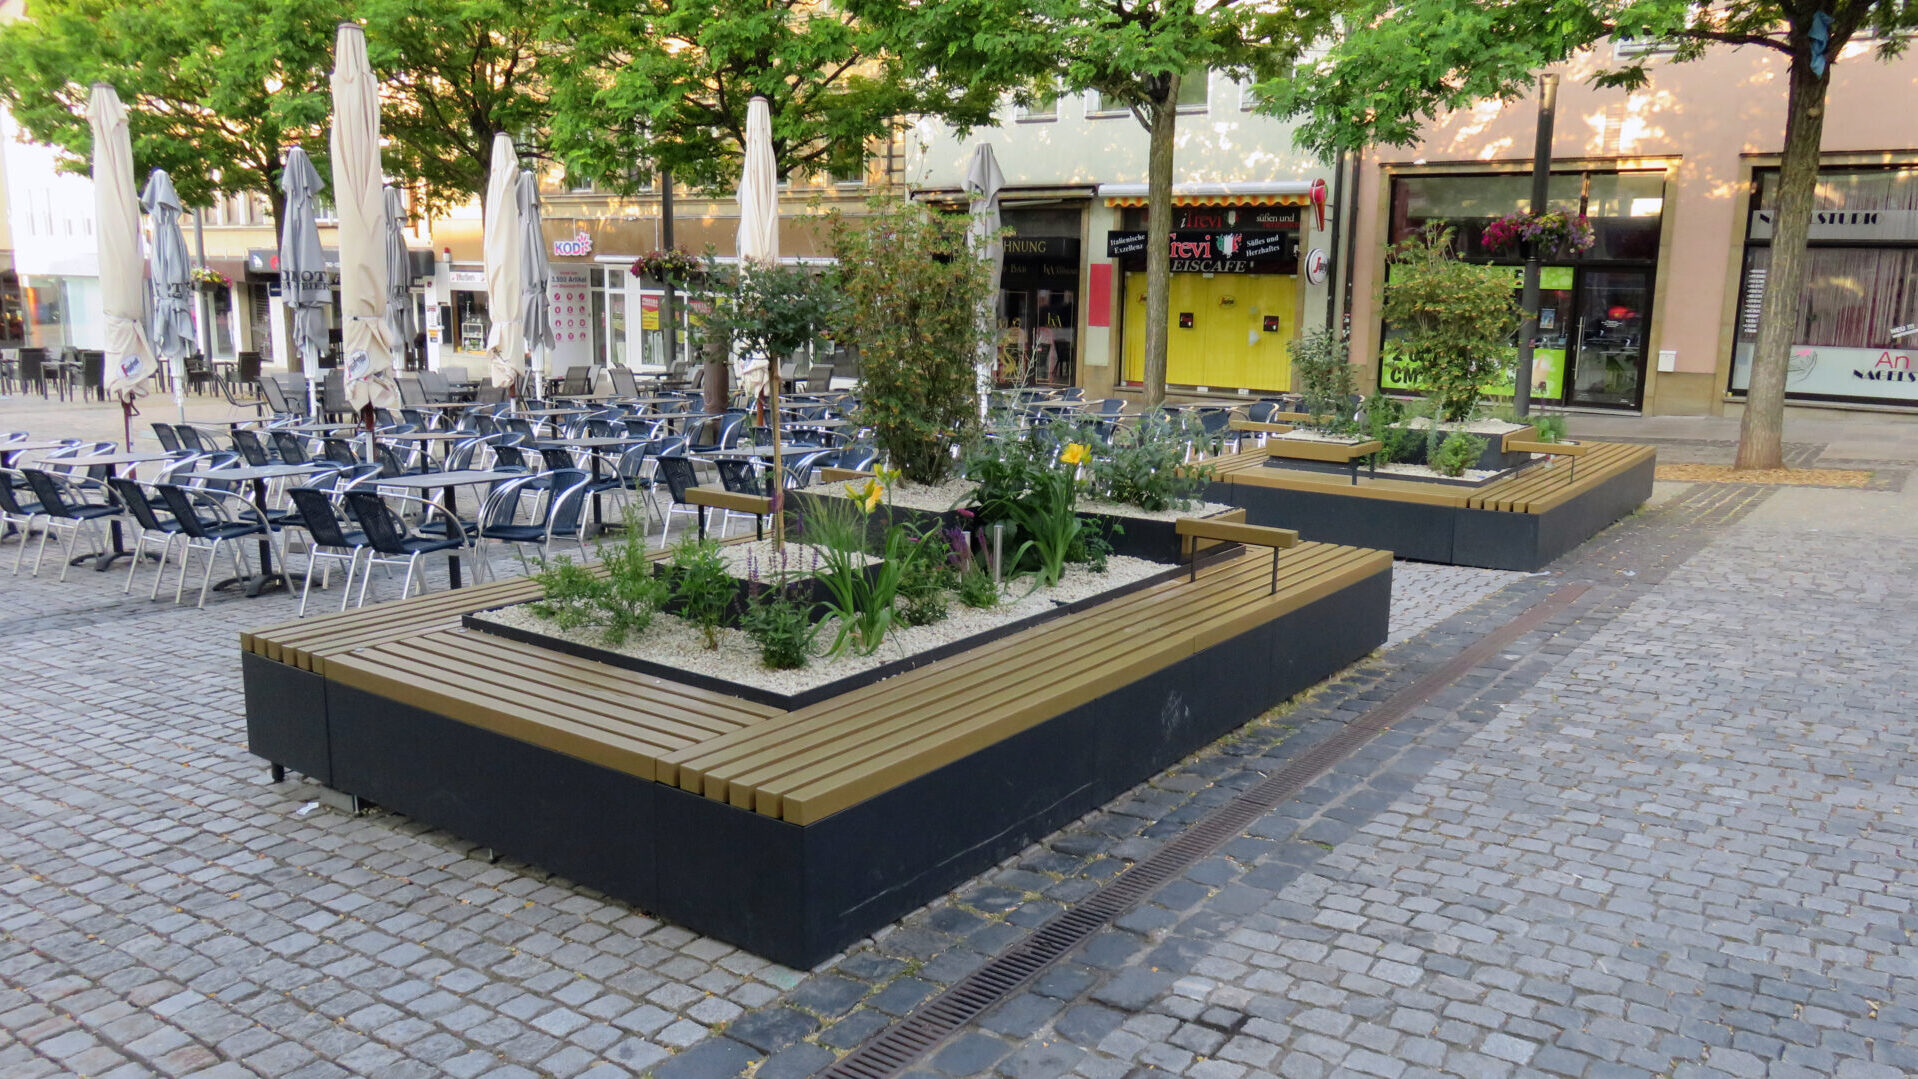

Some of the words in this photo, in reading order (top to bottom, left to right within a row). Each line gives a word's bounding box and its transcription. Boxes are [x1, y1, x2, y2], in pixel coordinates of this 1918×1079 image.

[1279, 213, 1295, 222] und
[1110, 234, 1146, 246] Italienische
[1266, 234, 1279, 243] und
[1003, 240, 1047, 253] HNUNG
[1114, 243, 1144, 254] Exzellenz
[1169, 232, 1212, 258] revi
[1246, 245, 1280, 257] Herzhaftes
[1875, 351, 1910, 369] An
